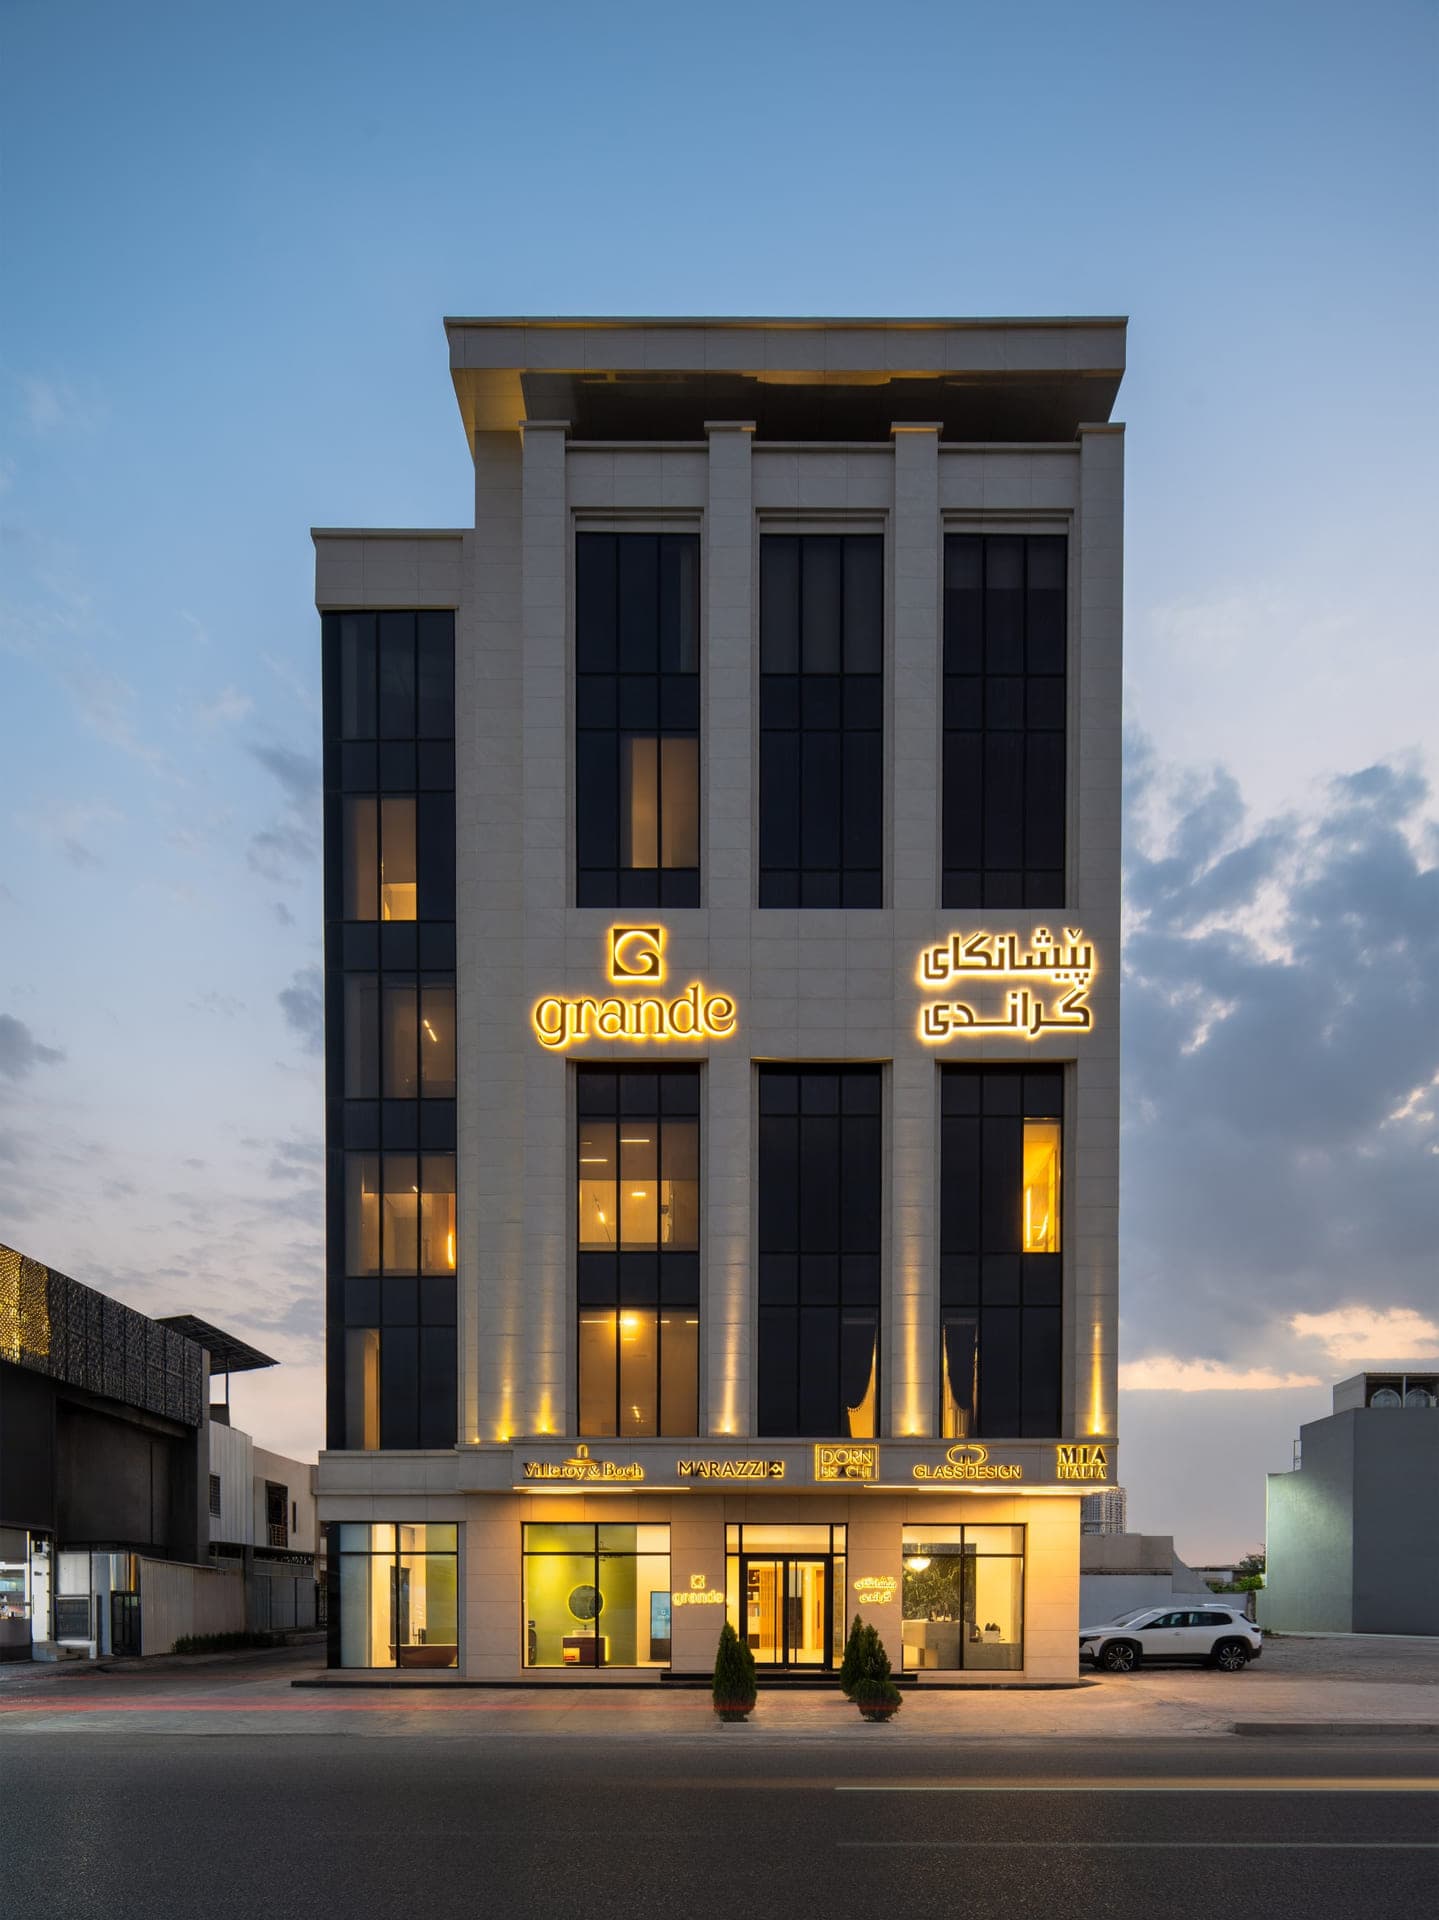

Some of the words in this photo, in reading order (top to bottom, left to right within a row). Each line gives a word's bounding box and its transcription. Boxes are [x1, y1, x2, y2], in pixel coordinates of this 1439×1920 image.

[535, 984, 736, 1047] grande
[821, 1448, 873, 1466] DORN
[1057, 1445, 1108, 1465] MIA
[522, 1461, 585, 1480] Villeroy
[587, 1462, 601, 1477] &
[602, 1461, 645, 1478] Boch
[677, 1460, 767, 1478] MARAZZI
[1056, 1464, 1108, 1480] ITALIA
